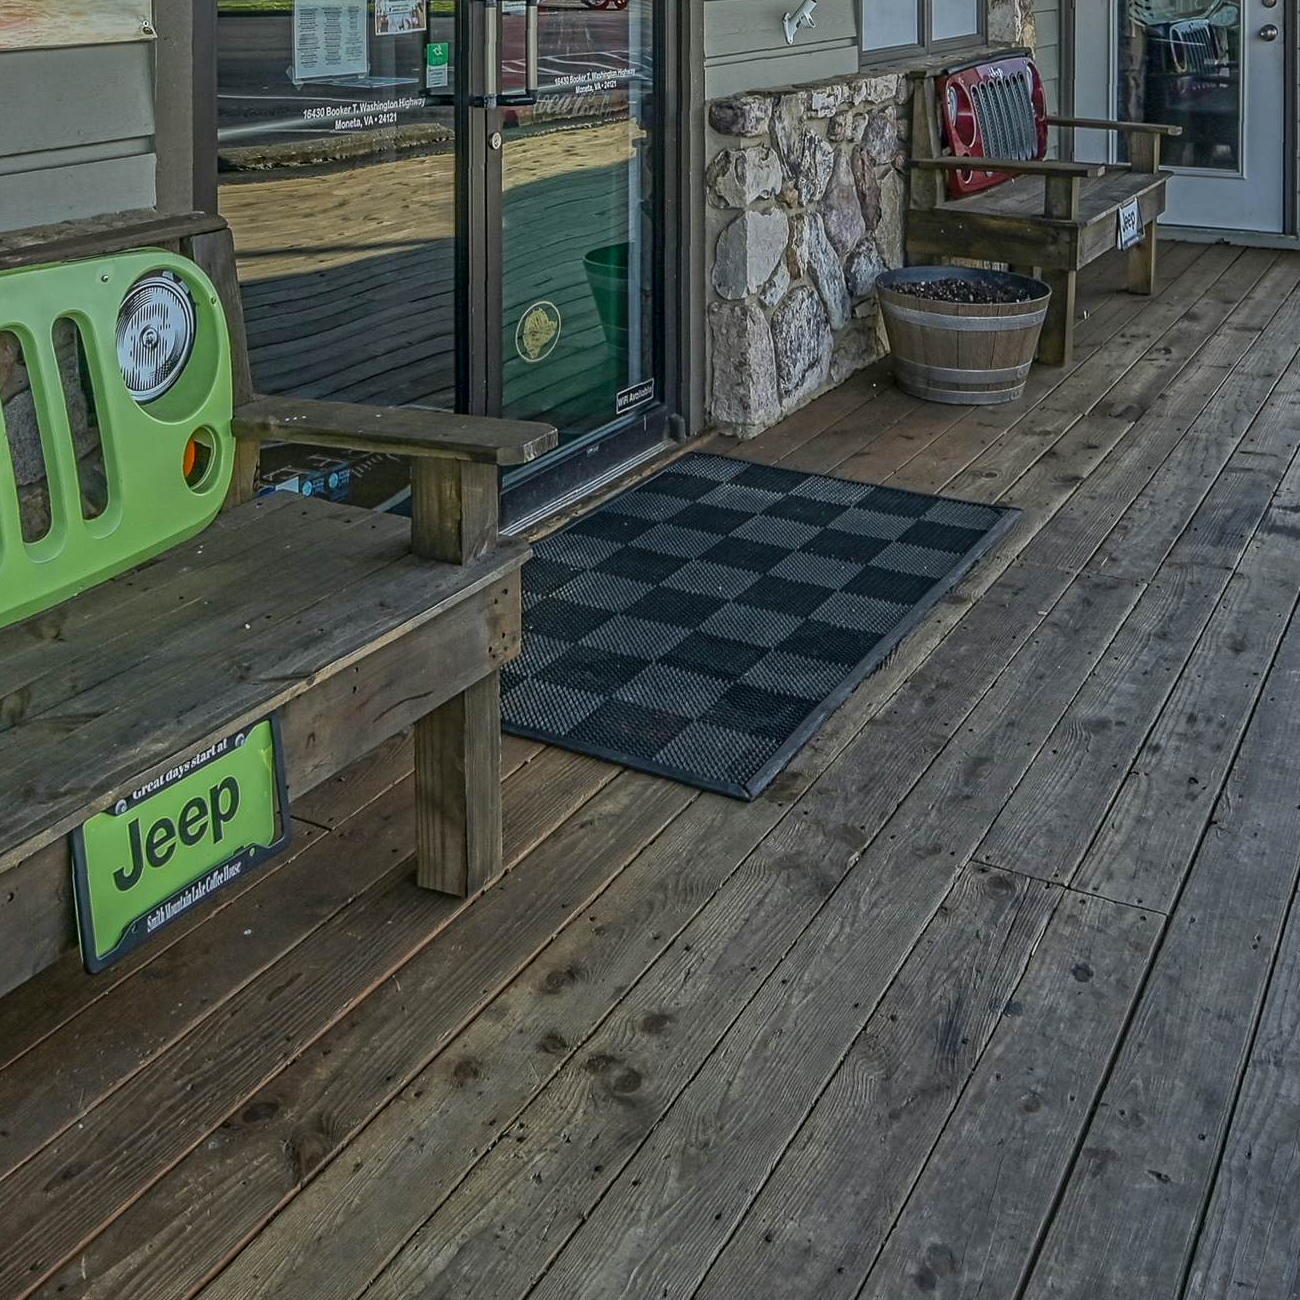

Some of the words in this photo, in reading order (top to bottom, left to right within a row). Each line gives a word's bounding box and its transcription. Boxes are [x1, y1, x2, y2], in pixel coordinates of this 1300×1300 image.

[326, 105, 351, 116] Booker
[360, 101, 399, 113] Washington
[399, 97, 426, 108] Highway
[335, 118, 362, 130] Moneta,
[364, 116, 374, 126] VA
[378, 112, 397, 124] 24121
[165, 761, 191, 781] days
[190, 744, 217, 768] start
[217, 738, 228, 752] at
[113, 776, 240, 892] Jeep
[147, 906, 166, 933] Smith
[165, 890, 192, 920] Mountain
[191, 881, 206, 902] Lake
[205, 870, 225, 892] Coffee
[223, 861, 242, 882] House
